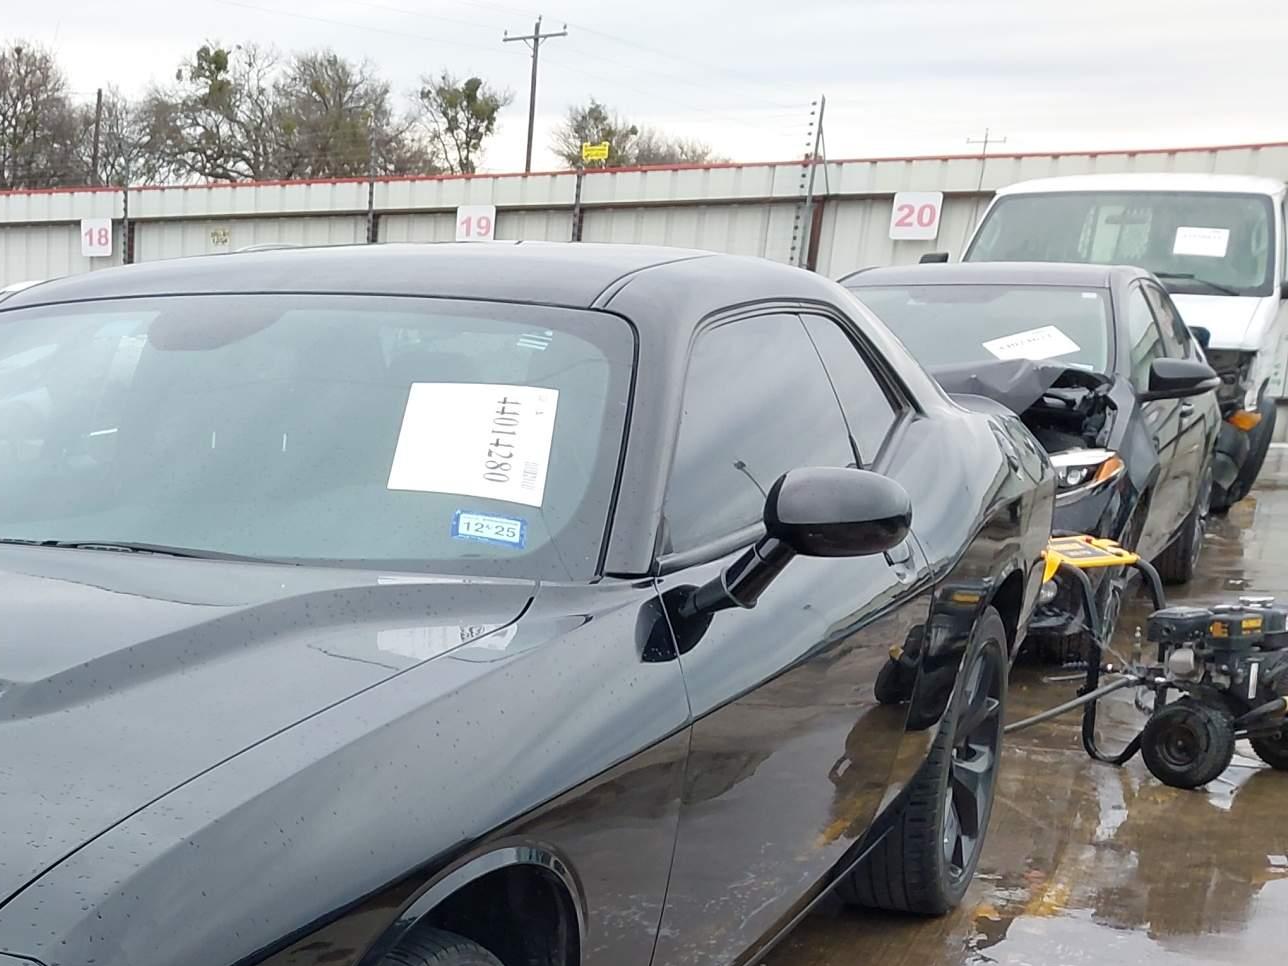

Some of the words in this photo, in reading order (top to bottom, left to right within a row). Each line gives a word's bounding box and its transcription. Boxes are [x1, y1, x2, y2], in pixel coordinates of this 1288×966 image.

[460, 215, 491, 237] 19
[894, 203, 937, 227] 20
[84, 228, 109, 246] 18
[483, 396, 522, 483] 44014280
[464, 521, 485, 534] 12
[494, 525, 517, 538] 25
